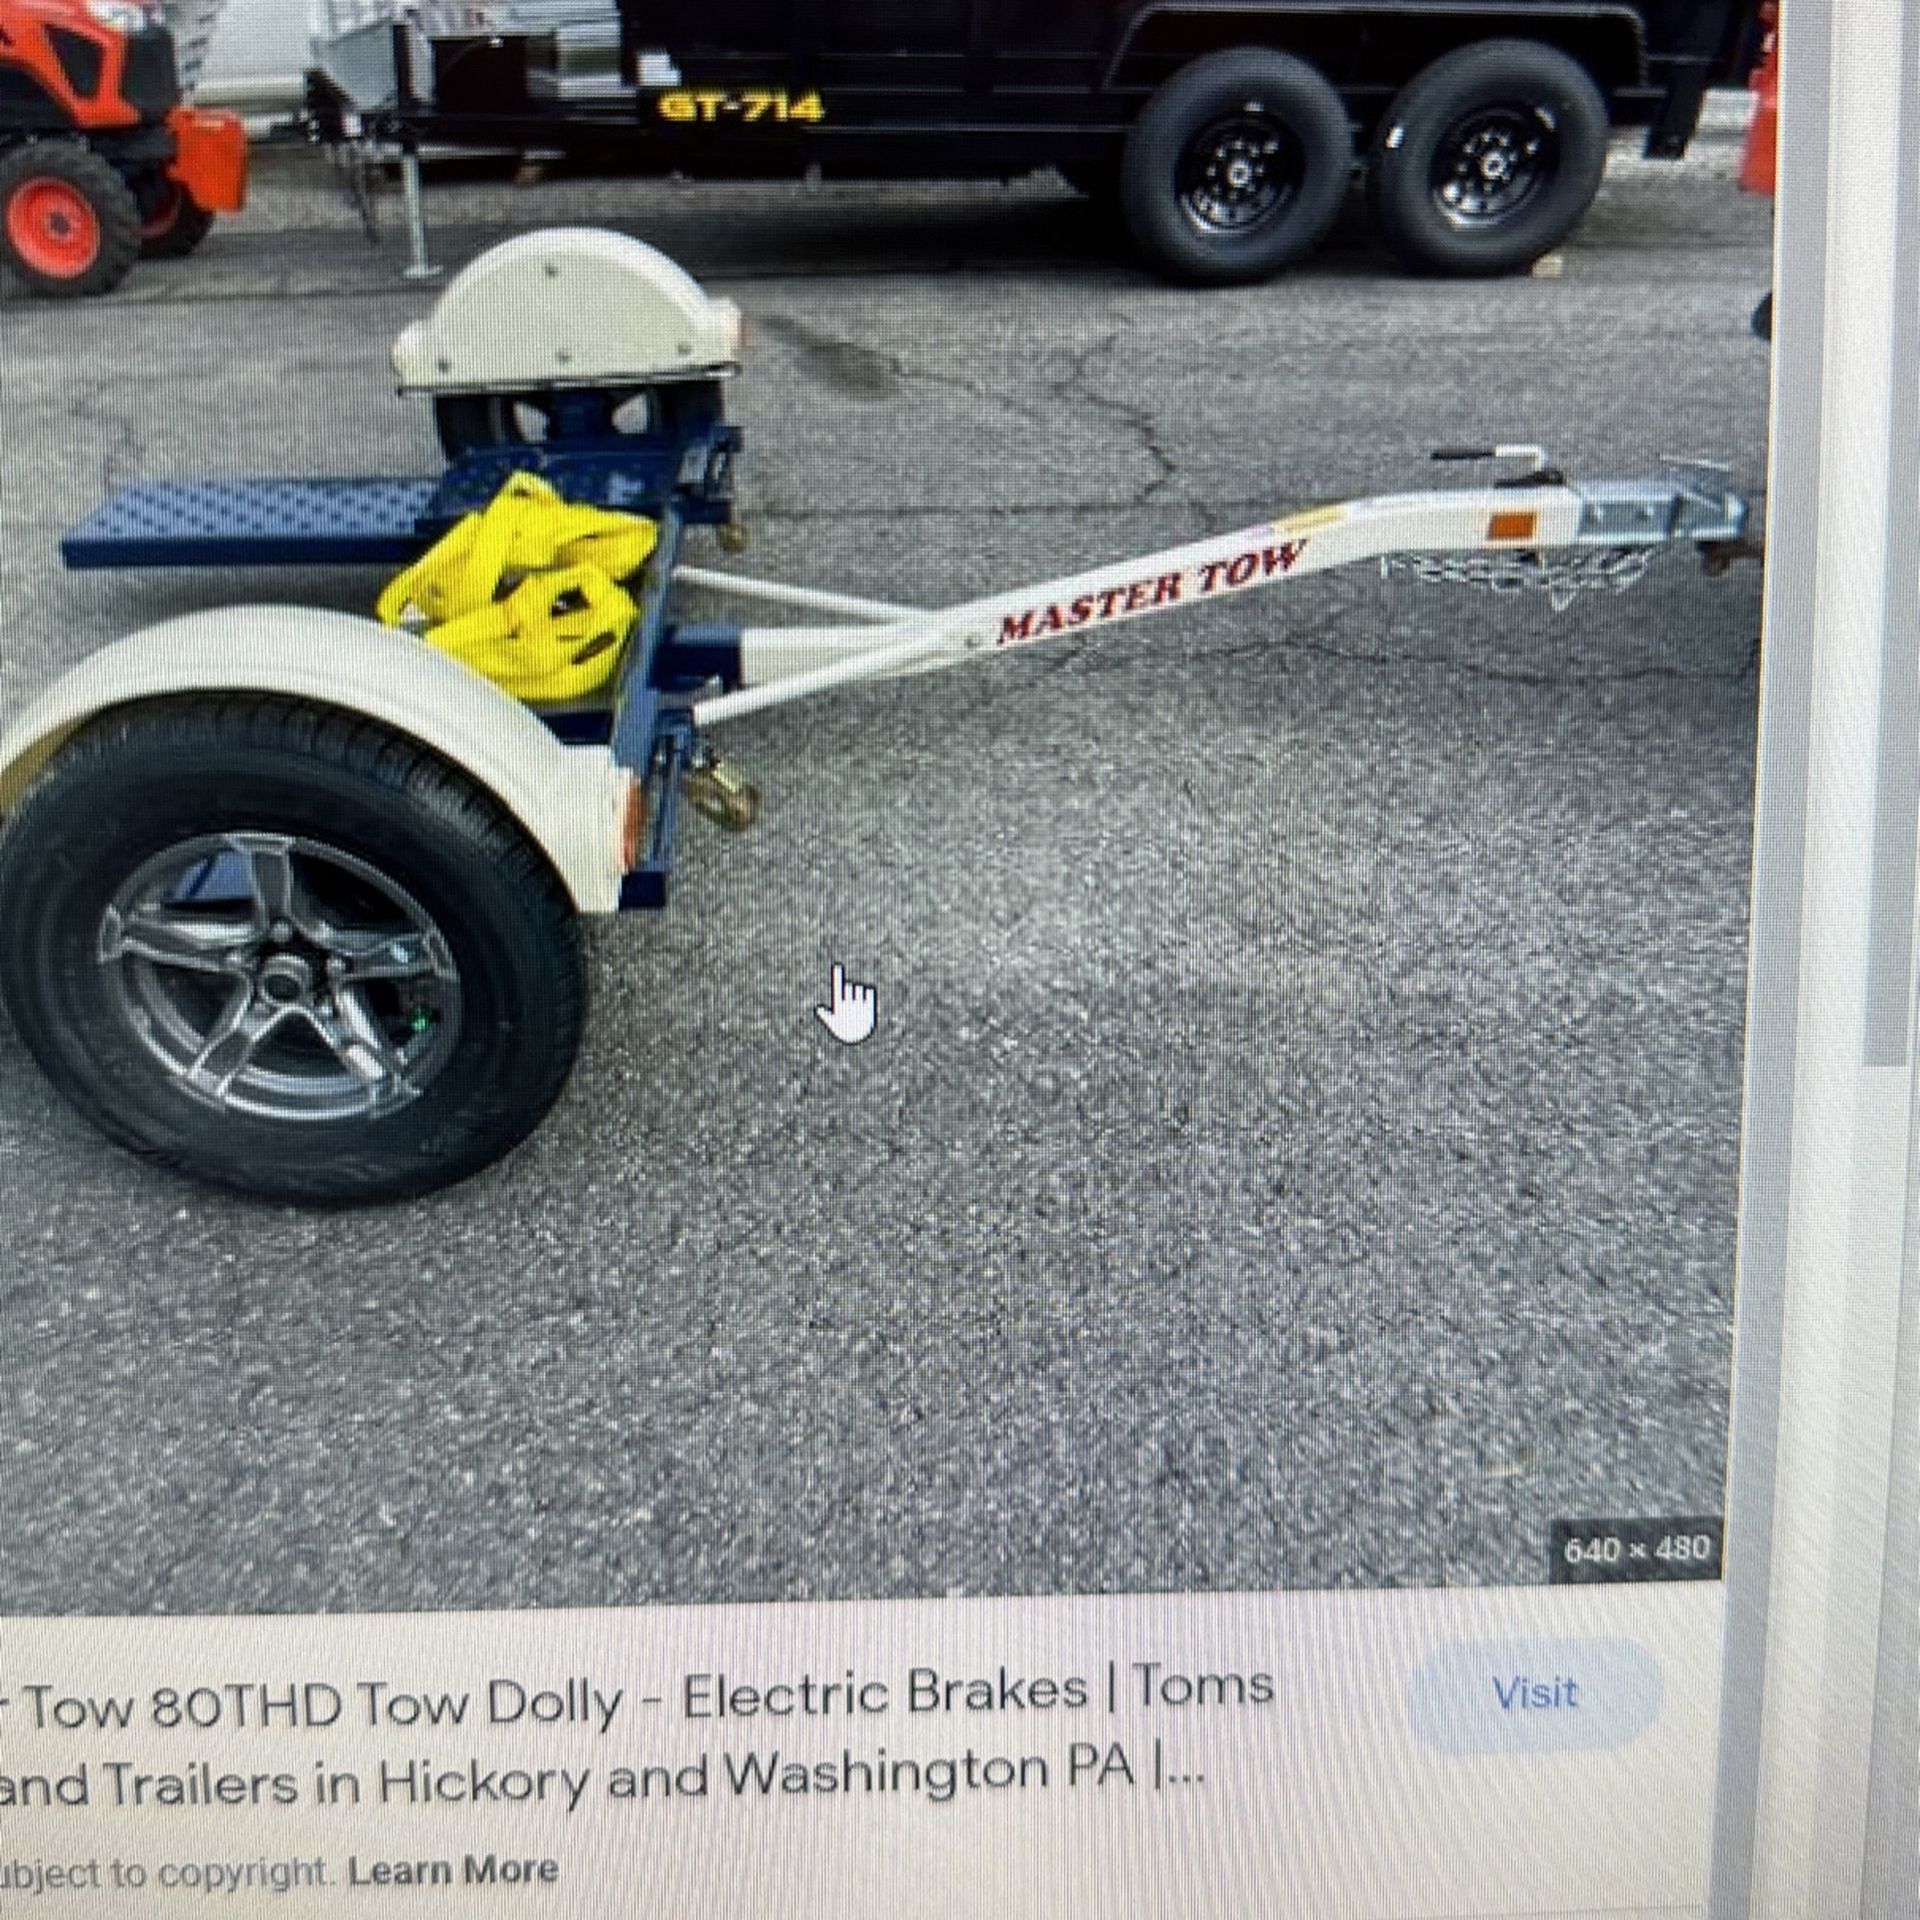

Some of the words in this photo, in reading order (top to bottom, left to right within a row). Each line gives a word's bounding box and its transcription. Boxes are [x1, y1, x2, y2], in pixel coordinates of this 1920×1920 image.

[658, 89, 825, 123] GT-714
[998, 573, 1186, 645] MASTER
[1199, 538, 1309, 593] TOW
[1564, 1536, 1621, 1564] 640
[1654, 1535, 1711, 1561] 480
[24, 1684, 135, 1729] Tow
[152, 1682, 343, 1729] 80THD
[357, 1681, 470, 1726] Tow
[488, 1678, 623, 1734] Dolly
[685, 1671, 890, 1718] Electric
[908, 1664, 1089, 1713] Brakes
[1132, 1661, 1275, 1707] Toms
[1493, 1675, 1578, 1709] Visit
[103, 1760, 299, 1806] Trailers
[316, 1760, 360, 1804] in
[380, 1758, 590, 1812] Hickory
[608, 1753, 708, 1800] and
[725, 1748, 1048, 1802] Washington
[1068, 1741, 1135, 1787] PA
[111, 1857, 146, 1889] to
[159, 1855, 336, 1894] copyright.
[349, 1855, 453, 1887] Learn
[464, 1854, 558, 1885] More
